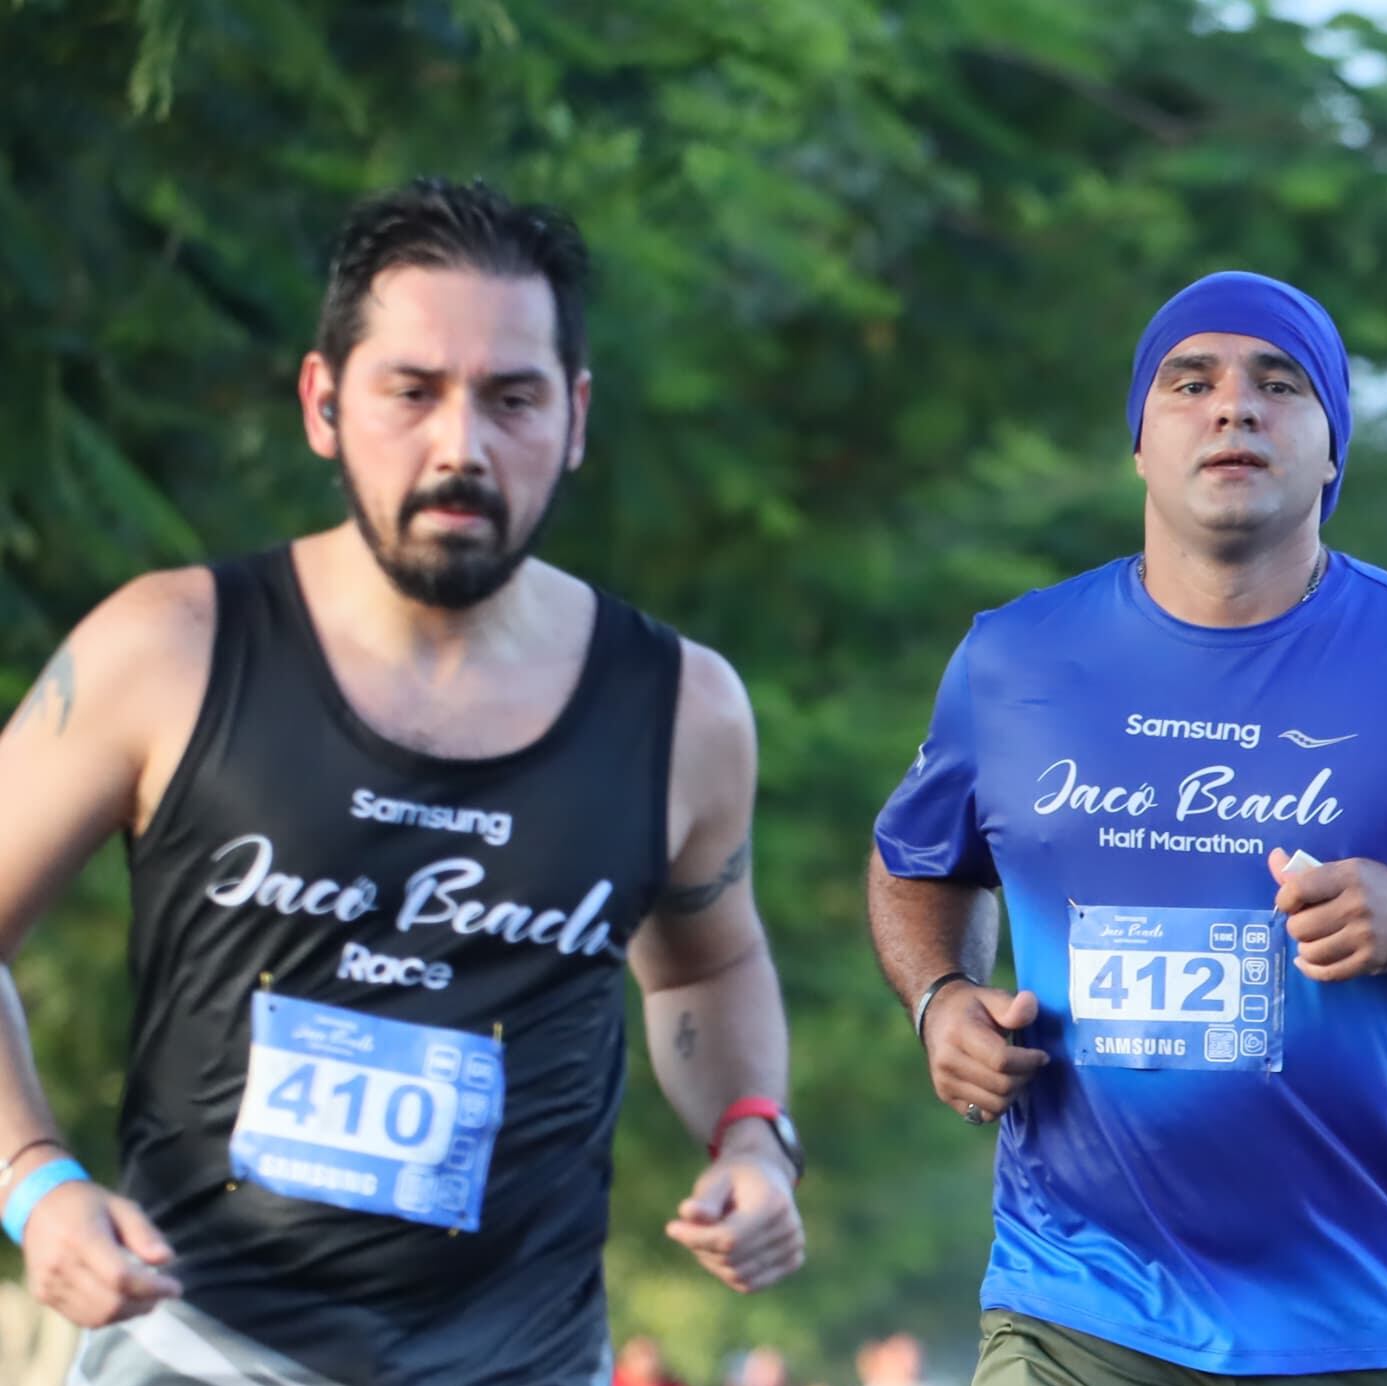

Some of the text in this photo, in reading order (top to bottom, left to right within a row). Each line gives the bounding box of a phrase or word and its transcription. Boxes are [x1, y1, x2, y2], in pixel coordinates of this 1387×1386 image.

[1125, 713, 1261, 749] Samsung
[350, 788, 513, 846] Samsung
[1175, 765, 1344, 825] Beach
[1098, 827, 1264, 854] Half Marathon
[396, 857, 616, 956] Beach
[336, 941, 453, 990] Race
[1088, 955, 1225, 1012] 412
[1094, 1036, 1186, 1056] SAMSUNG
[266, 1062, 436, 1148] 410
